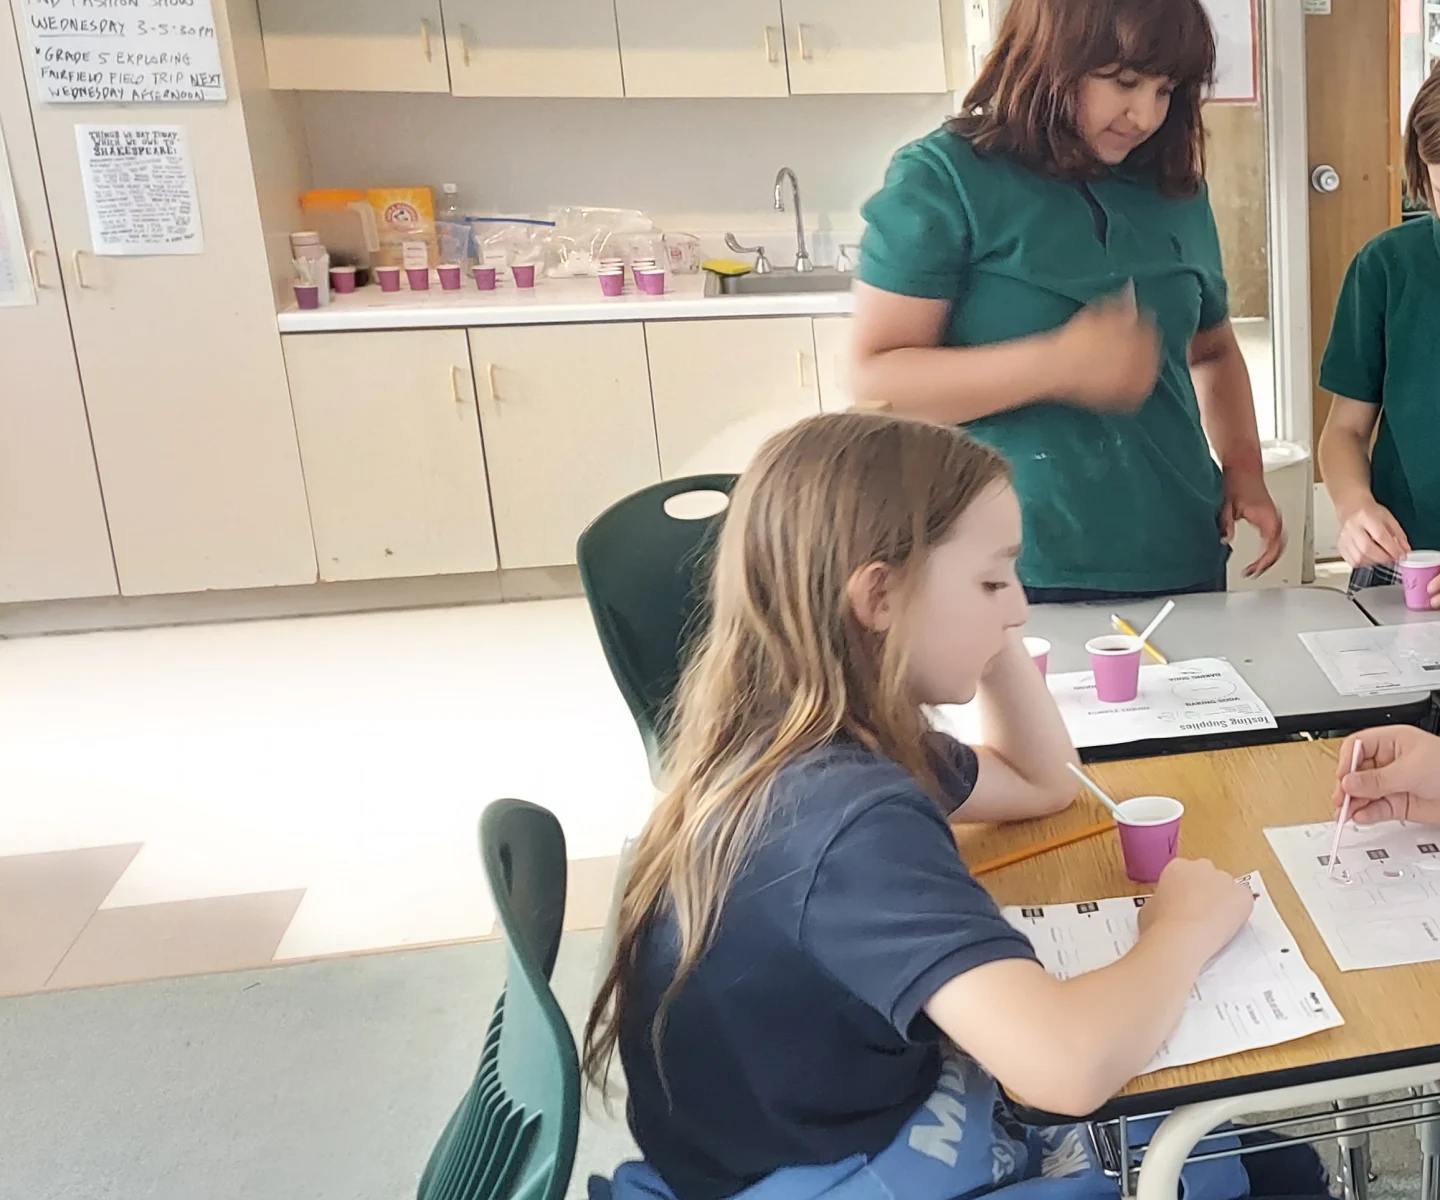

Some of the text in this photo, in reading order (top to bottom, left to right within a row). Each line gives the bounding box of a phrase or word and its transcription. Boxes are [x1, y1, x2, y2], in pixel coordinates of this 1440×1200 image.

[31, 14, 125, 35] WEDNESDAY
[98, 53, 110, 65] 5
[117, 52, 192, 66] EXPLORING
[41, 67, 221, 87] FAIRFIELD FIELD TRIP NEXT
[48, 86, 206, 101] WEDNESDAY AFTERNOON
[1179, 715, 1271, 732] Testing Supplies
